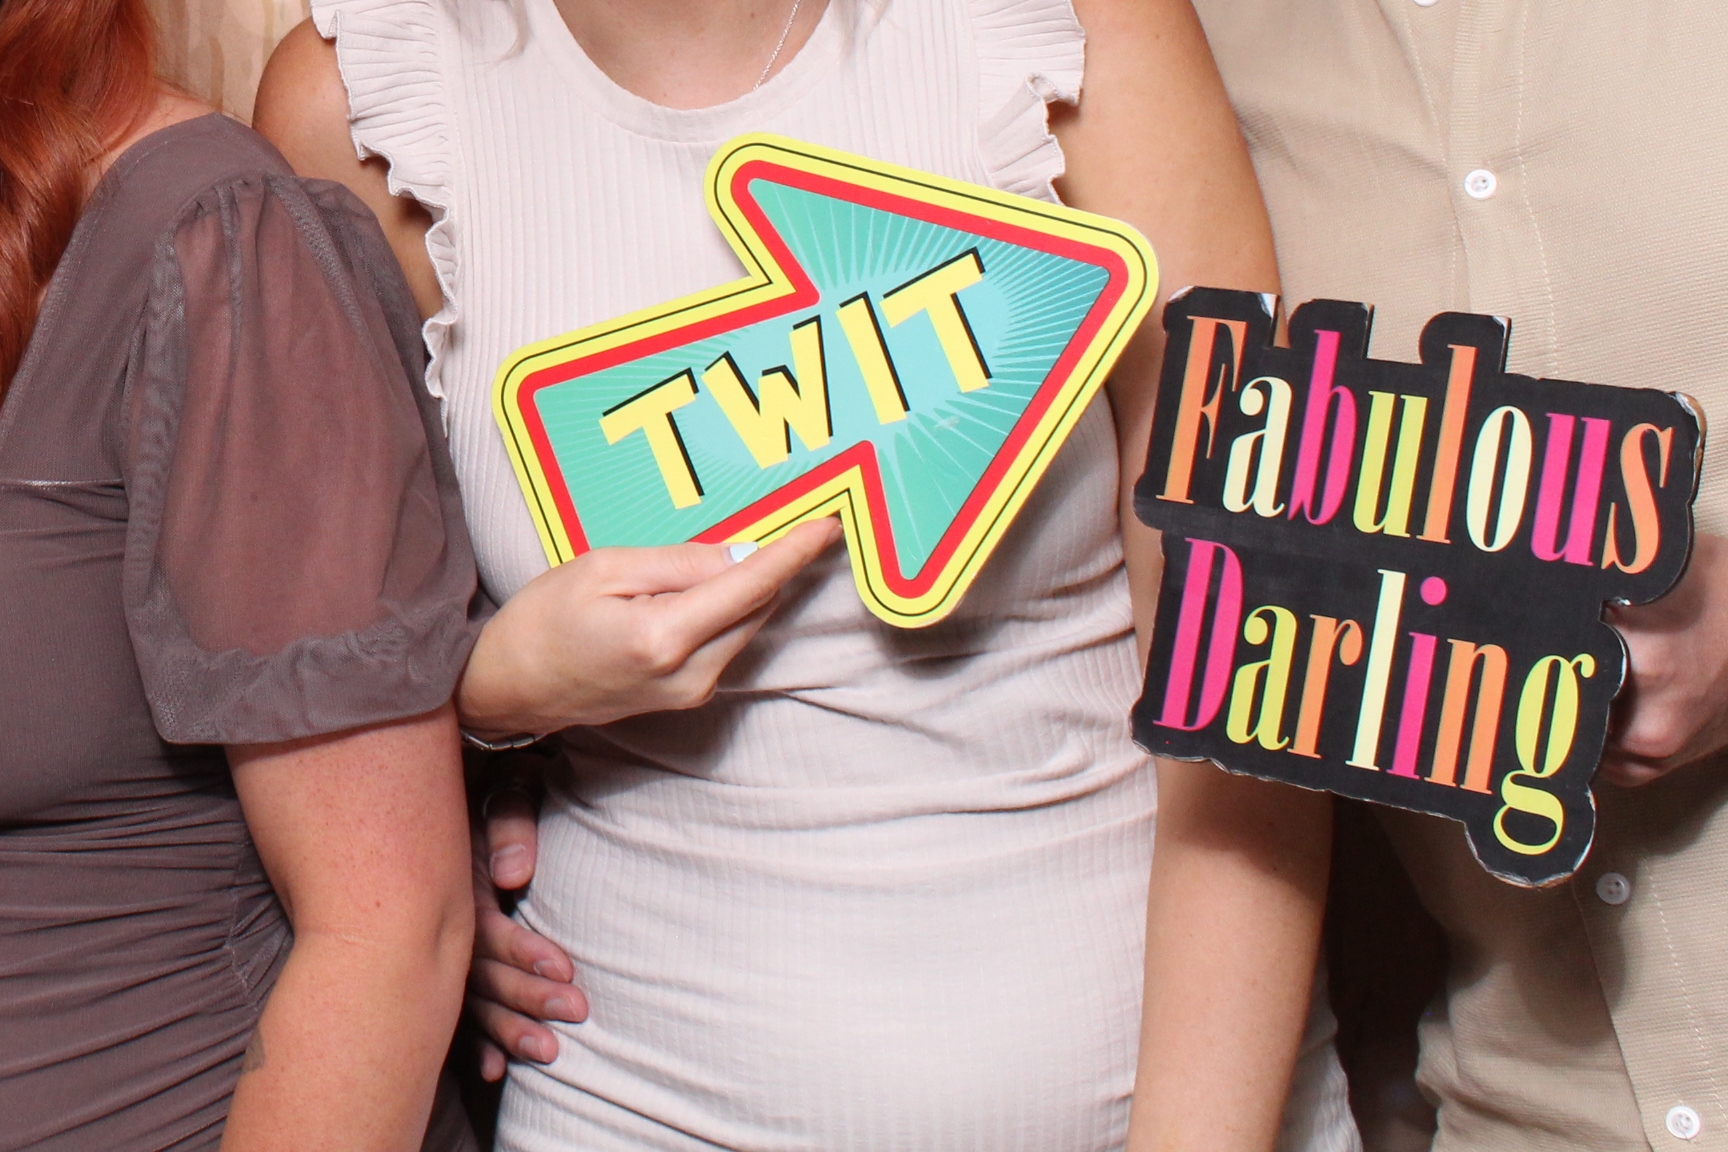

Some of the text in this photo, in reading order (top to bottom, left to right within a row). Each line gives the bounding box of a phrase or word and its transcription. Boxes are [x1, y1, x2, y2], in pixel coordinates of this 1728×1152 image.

[598, 246, 993, 510] TWIT
[1156, 315, 1673, 574] Fabulous
[1153, 537, 1596, 855] Darling
